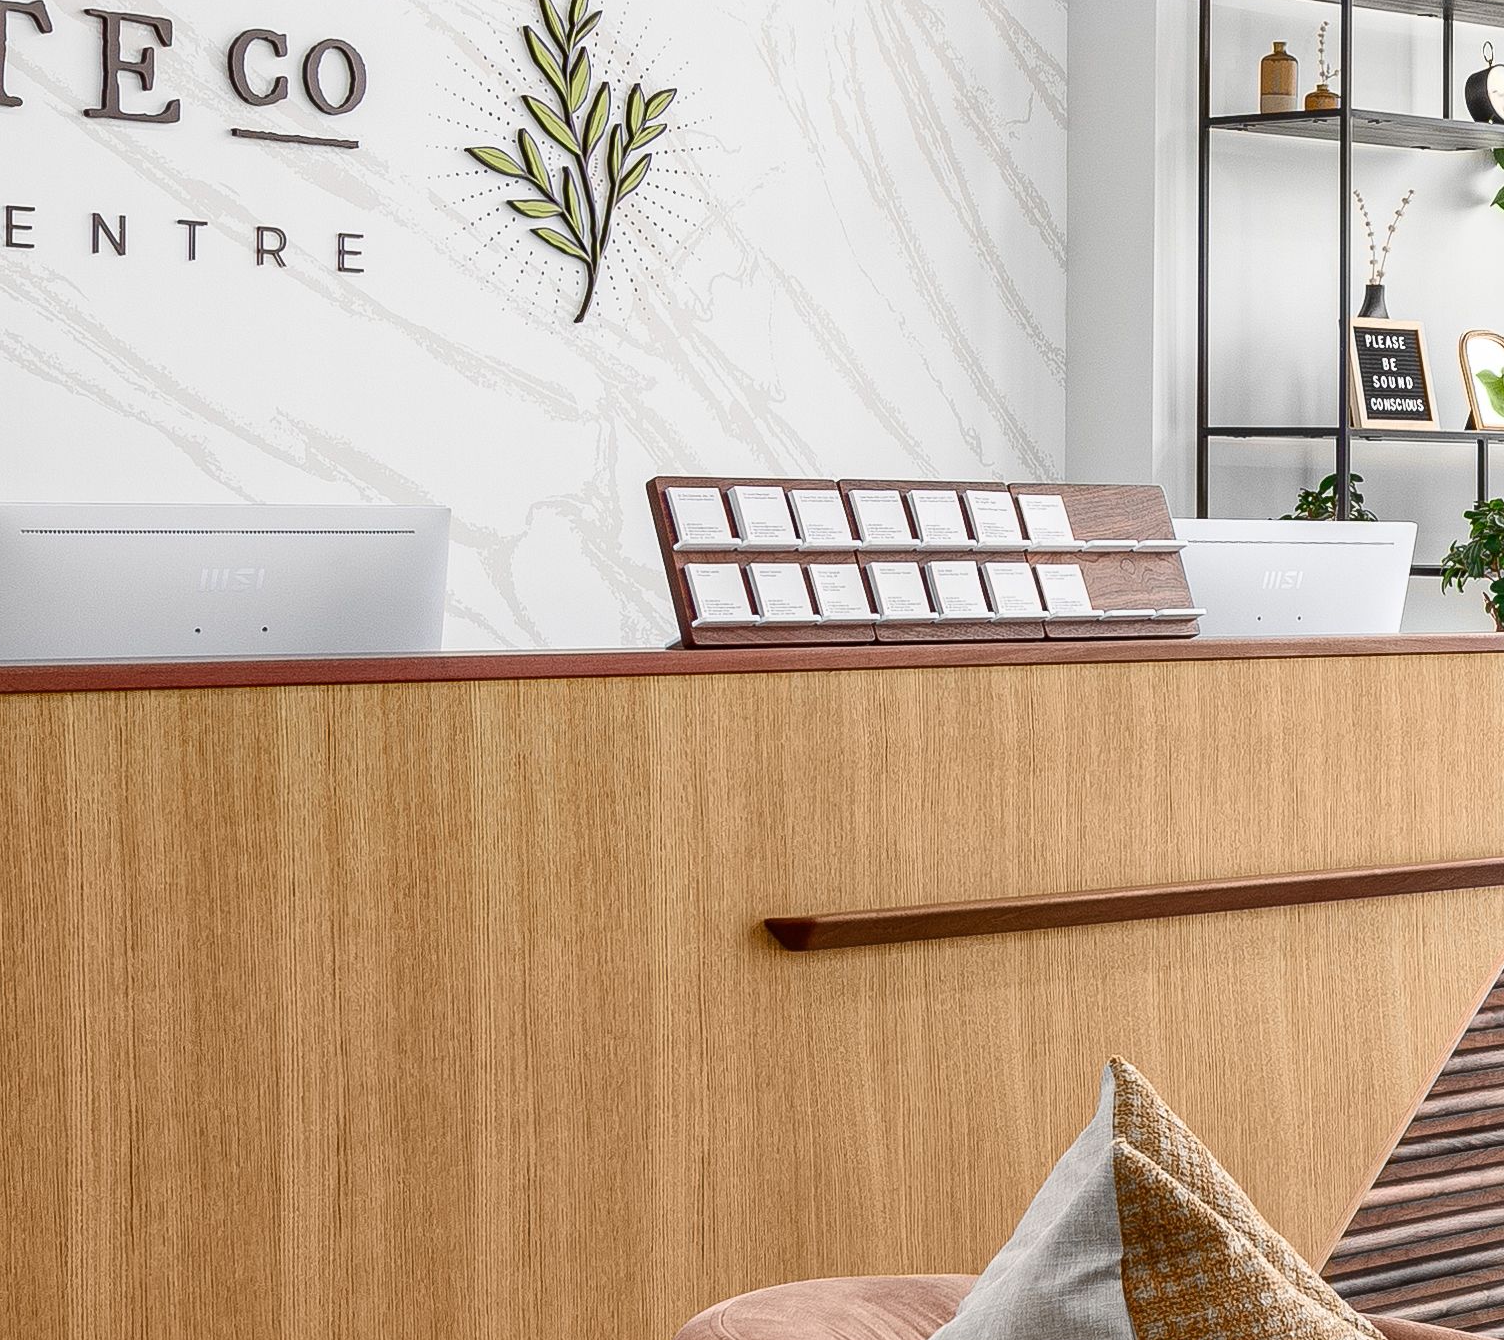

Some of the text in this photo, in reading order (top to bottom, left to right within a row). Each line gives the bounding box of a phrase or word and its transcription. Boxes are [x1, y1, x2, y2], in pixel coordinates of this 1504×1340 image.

[226, 27, 368, 118] CO
[1364, 333, 1407, 350] PLEASE
[1381, 357, 1398, 371] BE
[1372, 374, 1414, 390] SOUND
[1370, 397, 1425, 412] CONSCIOUS
